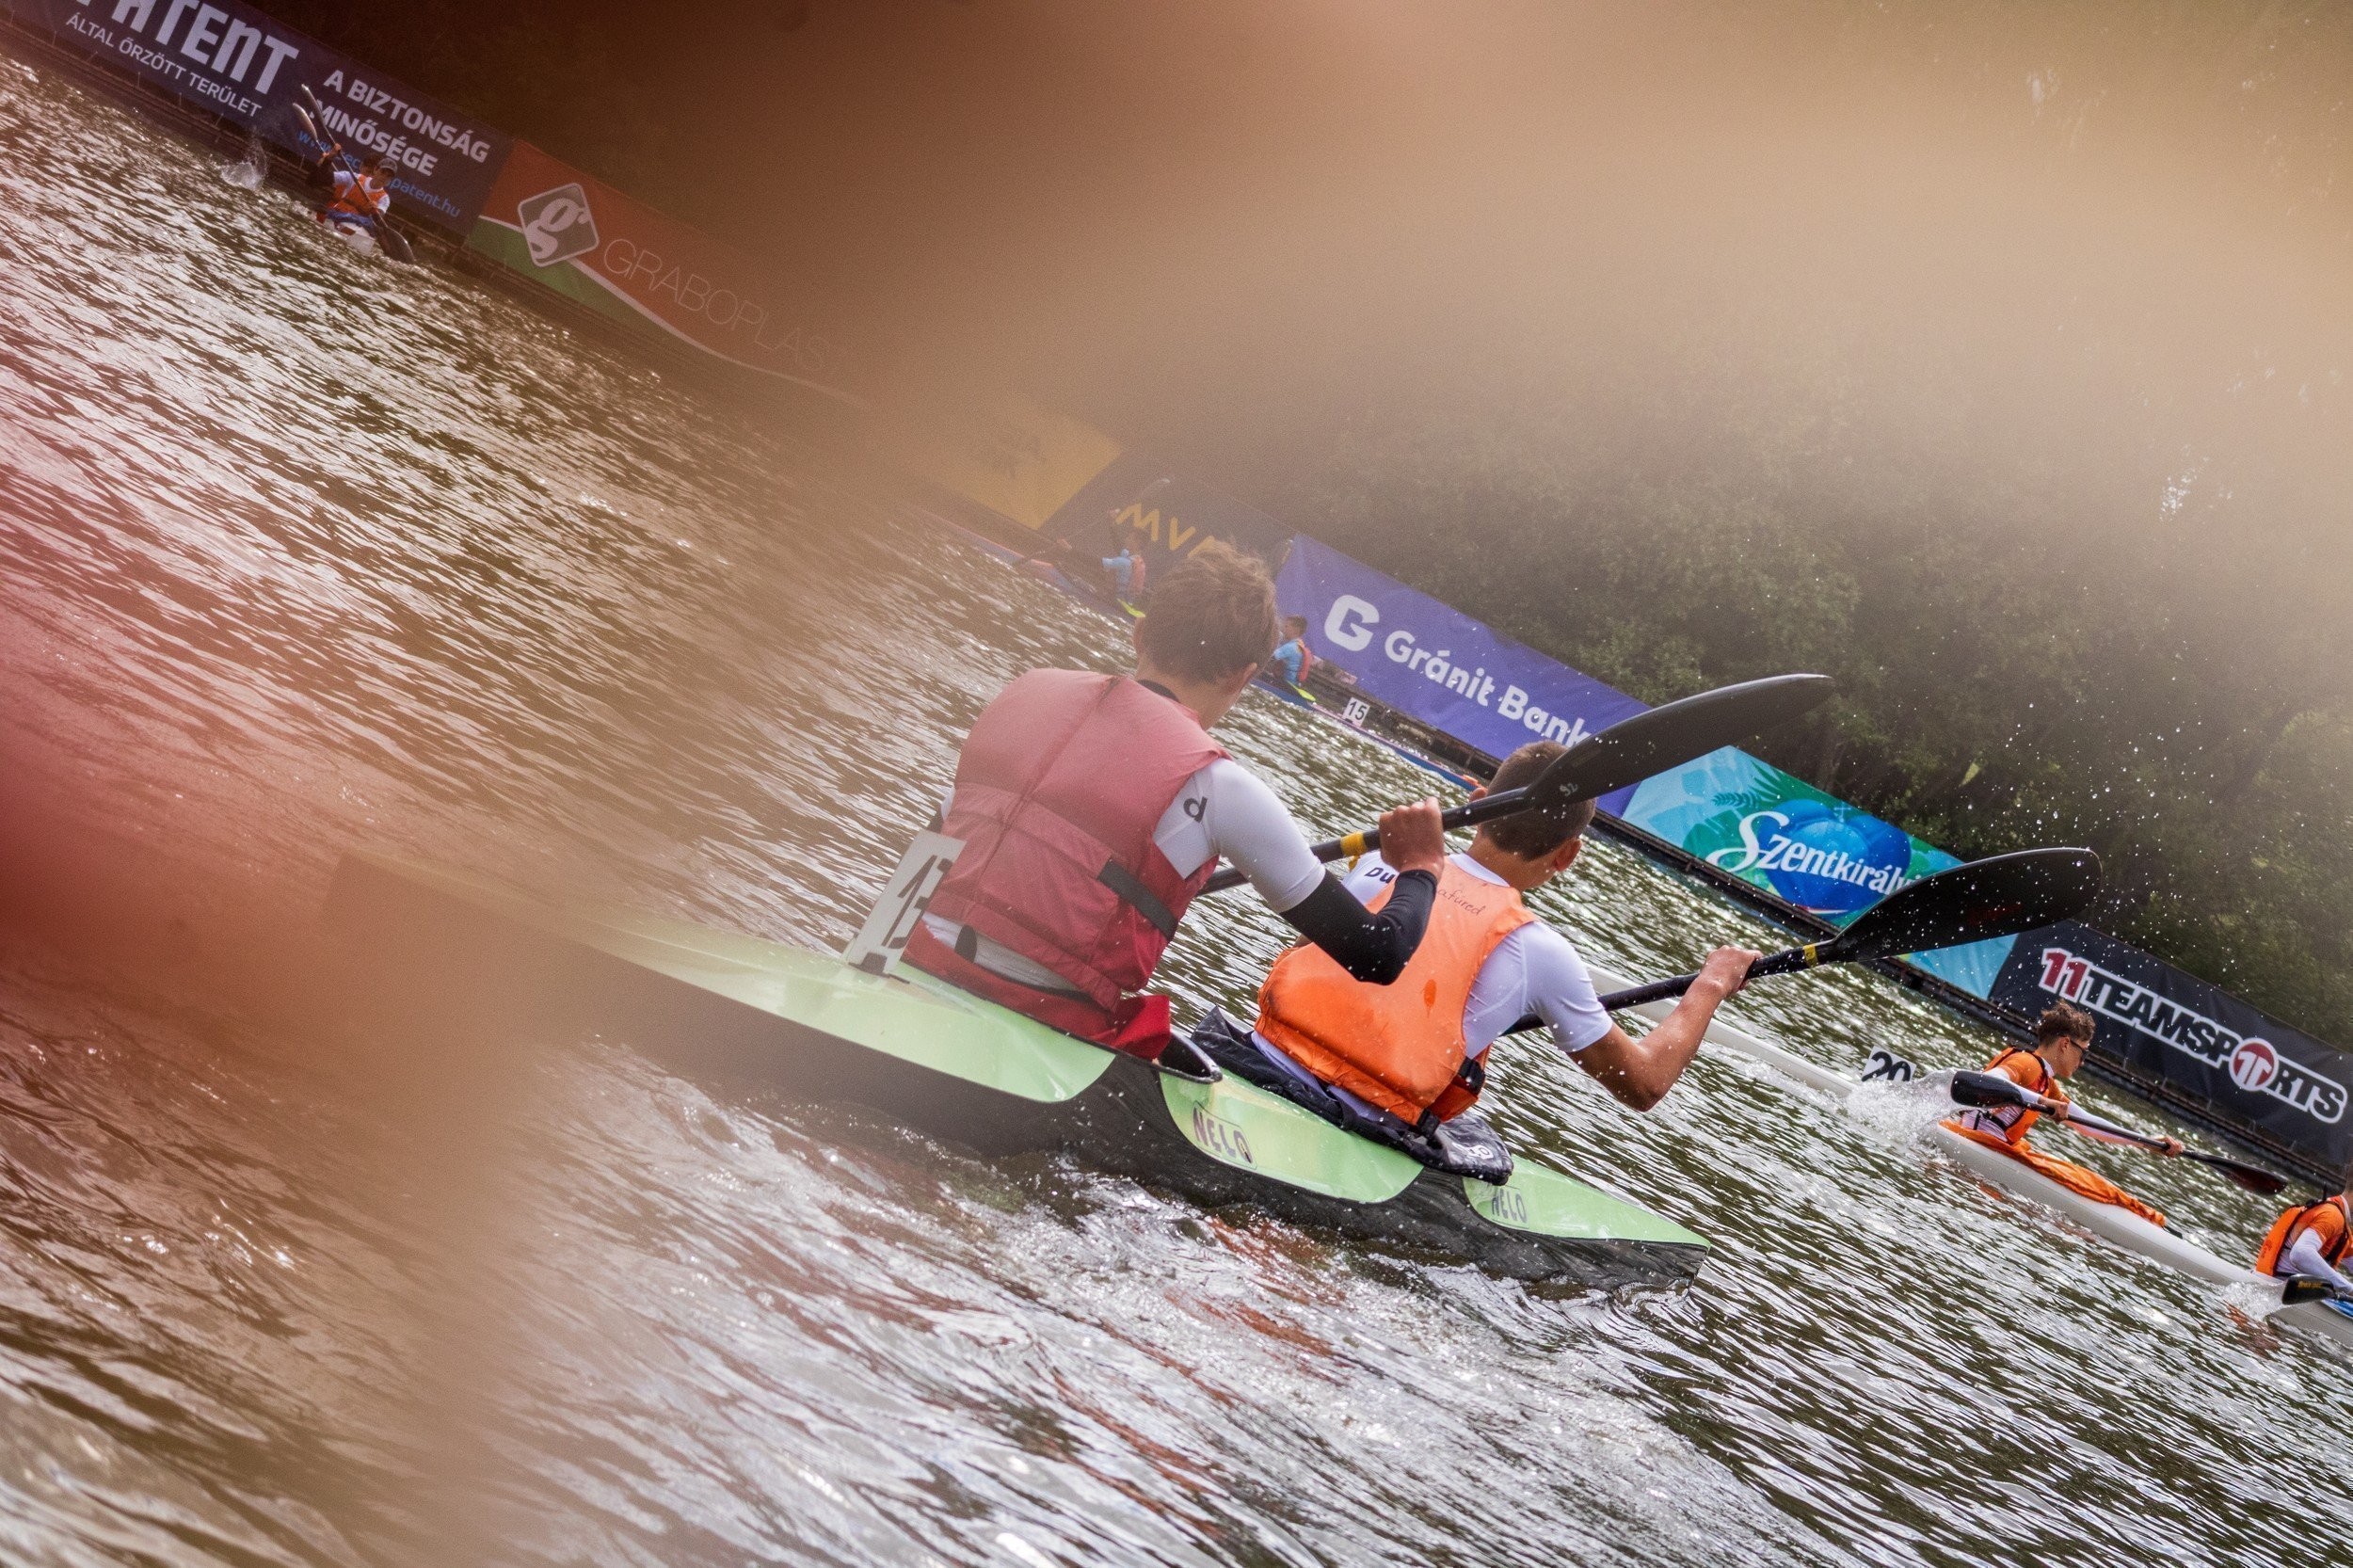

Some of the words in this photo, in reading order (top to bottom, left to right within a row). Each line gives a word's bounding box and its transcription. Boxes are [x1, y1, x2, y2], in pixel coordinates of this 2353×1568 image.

[66, 13, 115, 47] ÁLTAL
[119, 37, 186, 80] ŐRZÖTT
[189, 72, 263, 118] TERÜLET
[310, 99, 439, 177] MINŐSÉGE
[323, 69, 344, 93] A
[347, 79, 491, 163] BIZTONSÁG
[603, 238, 840, 375] GRABOPLAS
[1115, 502, 1215, 558] MV
[1348, 700, 1368, 721] 15
[1385, 631, 1495, 706] Gránit
[1497, 684, 1592, 749] Bank
[1705, 810, 1922, 895] Szentkirál
[1193, 1106, 1254, 1164] NELO
